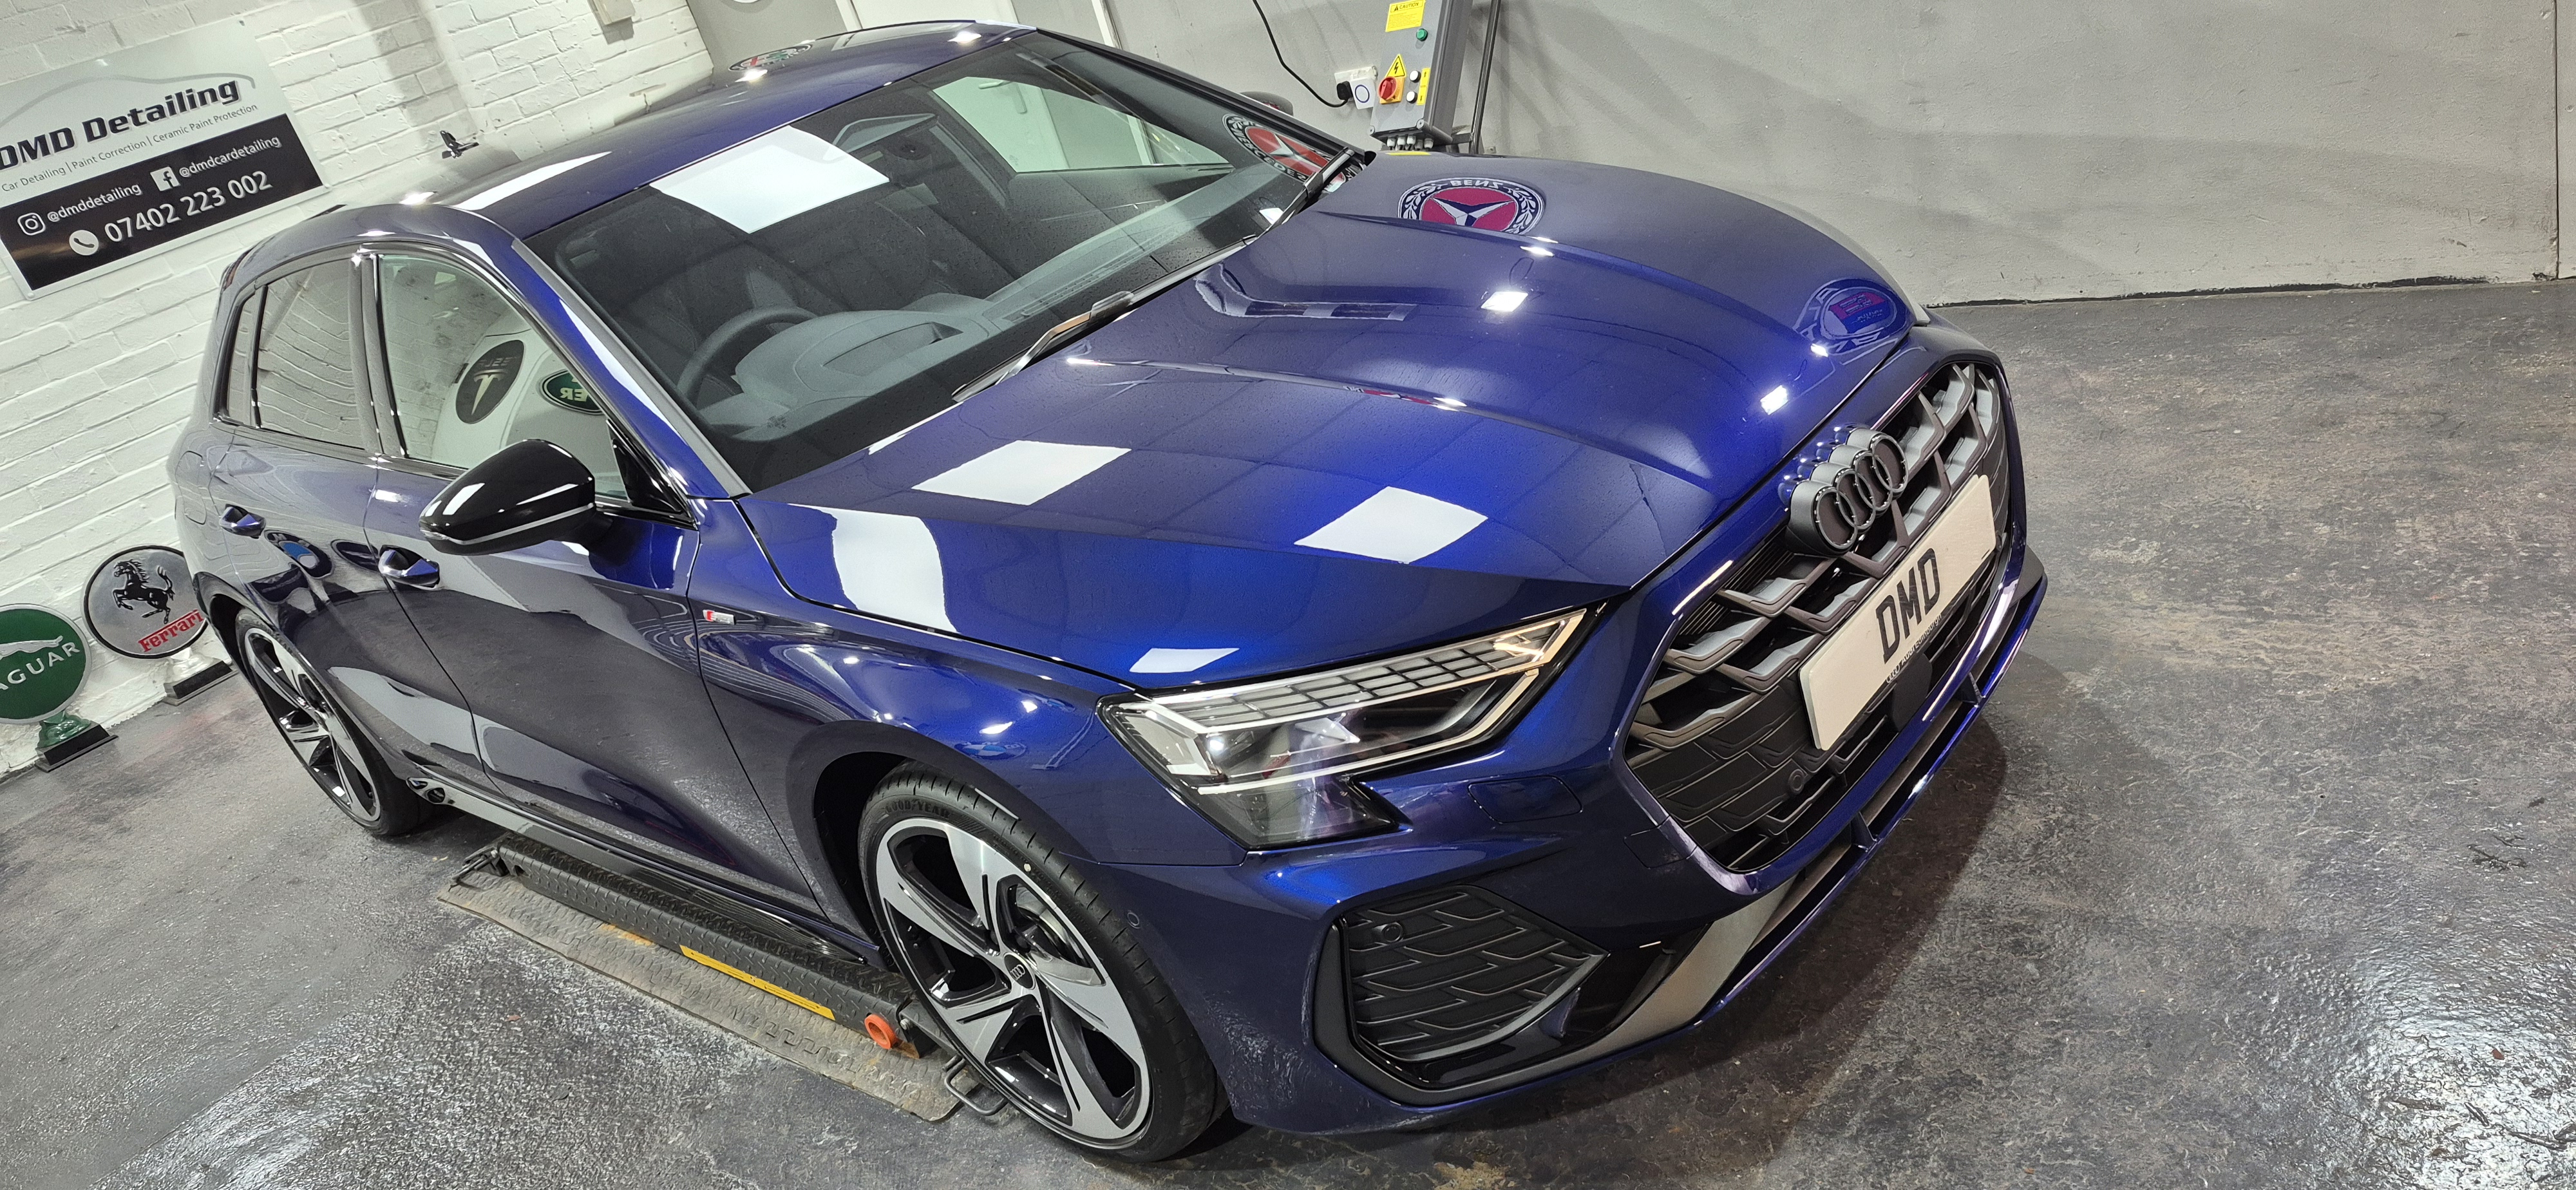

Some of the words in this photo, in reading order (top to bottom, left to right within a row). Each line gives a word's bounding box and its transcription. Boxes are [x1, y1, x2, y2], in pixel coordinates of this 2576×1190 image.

[0, 128, 75, 170] DMD
[82, 80, 240, 142] Detailing
[153, 127, 189, 143] Ceramic
[189, 118, 213, 131] Paint
[213, 103, 258, 124] Protection
[72, 156, 97, 169] Paint
[99, 140, 146, 160] Correction
[179, 136, 282, 178] @dmdcardetailing
[2, 182, 19, 191] Car
[20, 165, 66, 186] Detailing
[47, 184, 142, 222] @dmddetailing
[104, 203, 182, 243] 07402
[180, 187, 225, 216] 223
[227, 171, 273, 200] 002
[1875, 547, 1940, 665] DMD
[138, 609, 205, 652] Ferrari
